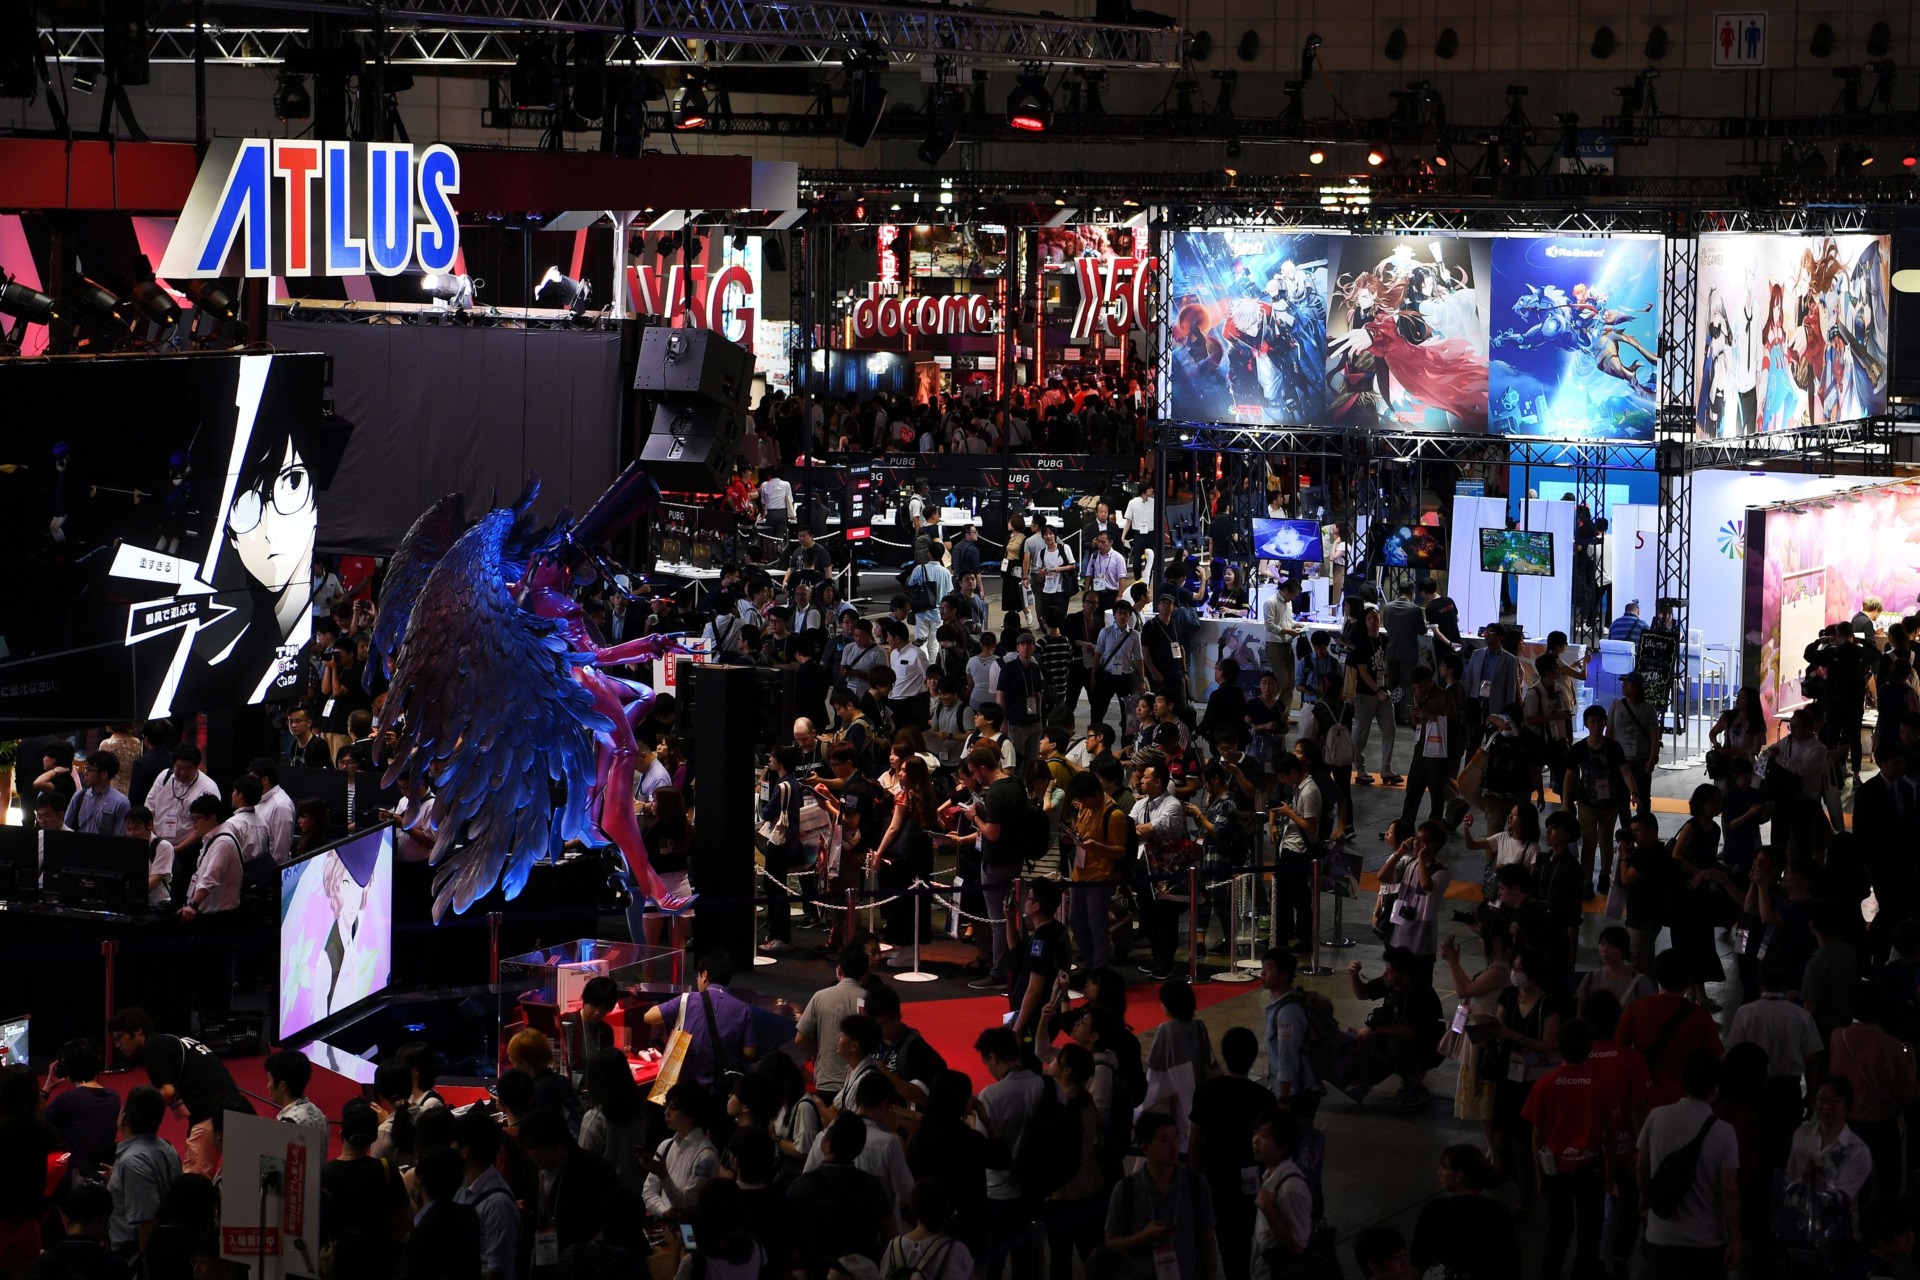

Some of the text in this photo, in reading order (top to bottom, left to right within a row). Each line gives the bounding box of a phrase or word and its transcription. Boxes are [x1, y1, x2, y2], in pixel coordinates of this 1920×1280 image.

[1595, 136, 1606, 152] 6
[194, 140, 460, 277] ATLUS
[853, 281, 991, 339] docomo
[1400, 414, 1425, 423] GAMES
[889, 457, 916, 466] PUBG
[1037, 459, 1063, 468] PUBG
[870, 472, 883, 481] BG
[1008, 474, 1030, 483] UBG
[668, 510, 685, 520] PUBG
[1588, 1050, 1618, 1058] ocomo
[1555, 1076, 1592, 1085] docomo
